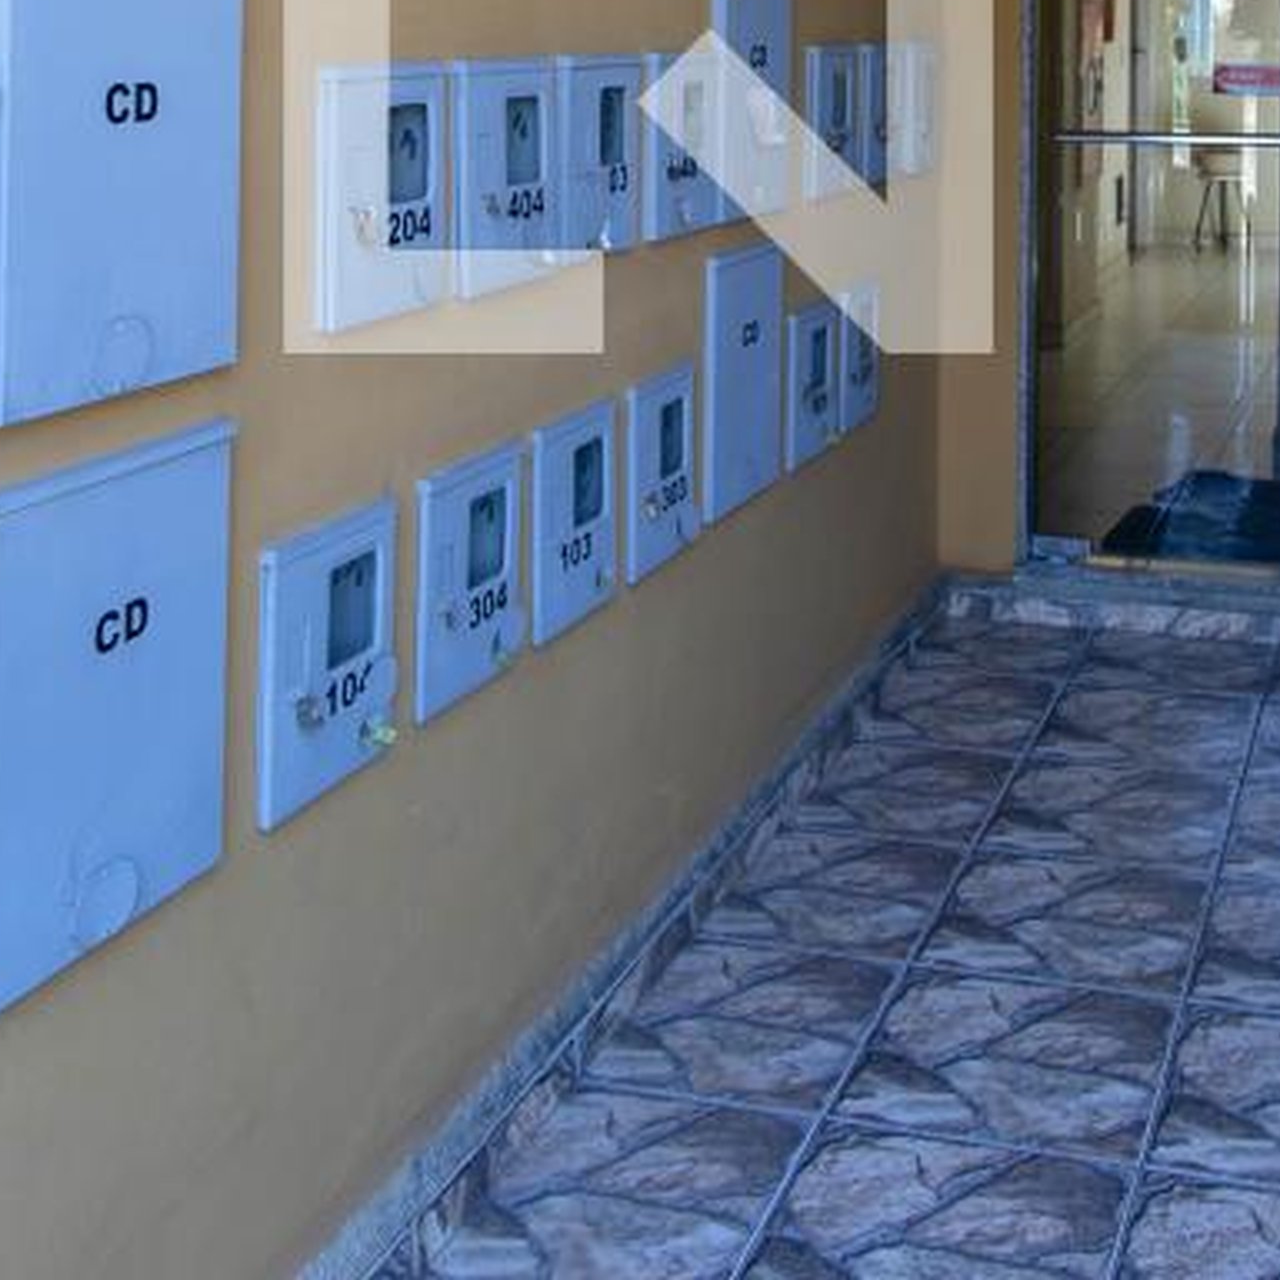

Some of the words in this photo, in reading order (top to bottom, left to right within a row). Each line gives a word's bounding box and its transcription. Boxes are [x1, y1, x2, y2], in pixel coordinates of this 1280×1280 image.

[106, 82, 158, 124] CD
[388, 207, 432, 248] 204
[560, 532, 593, 572] 103
[94, 596, 149, 655] CD
